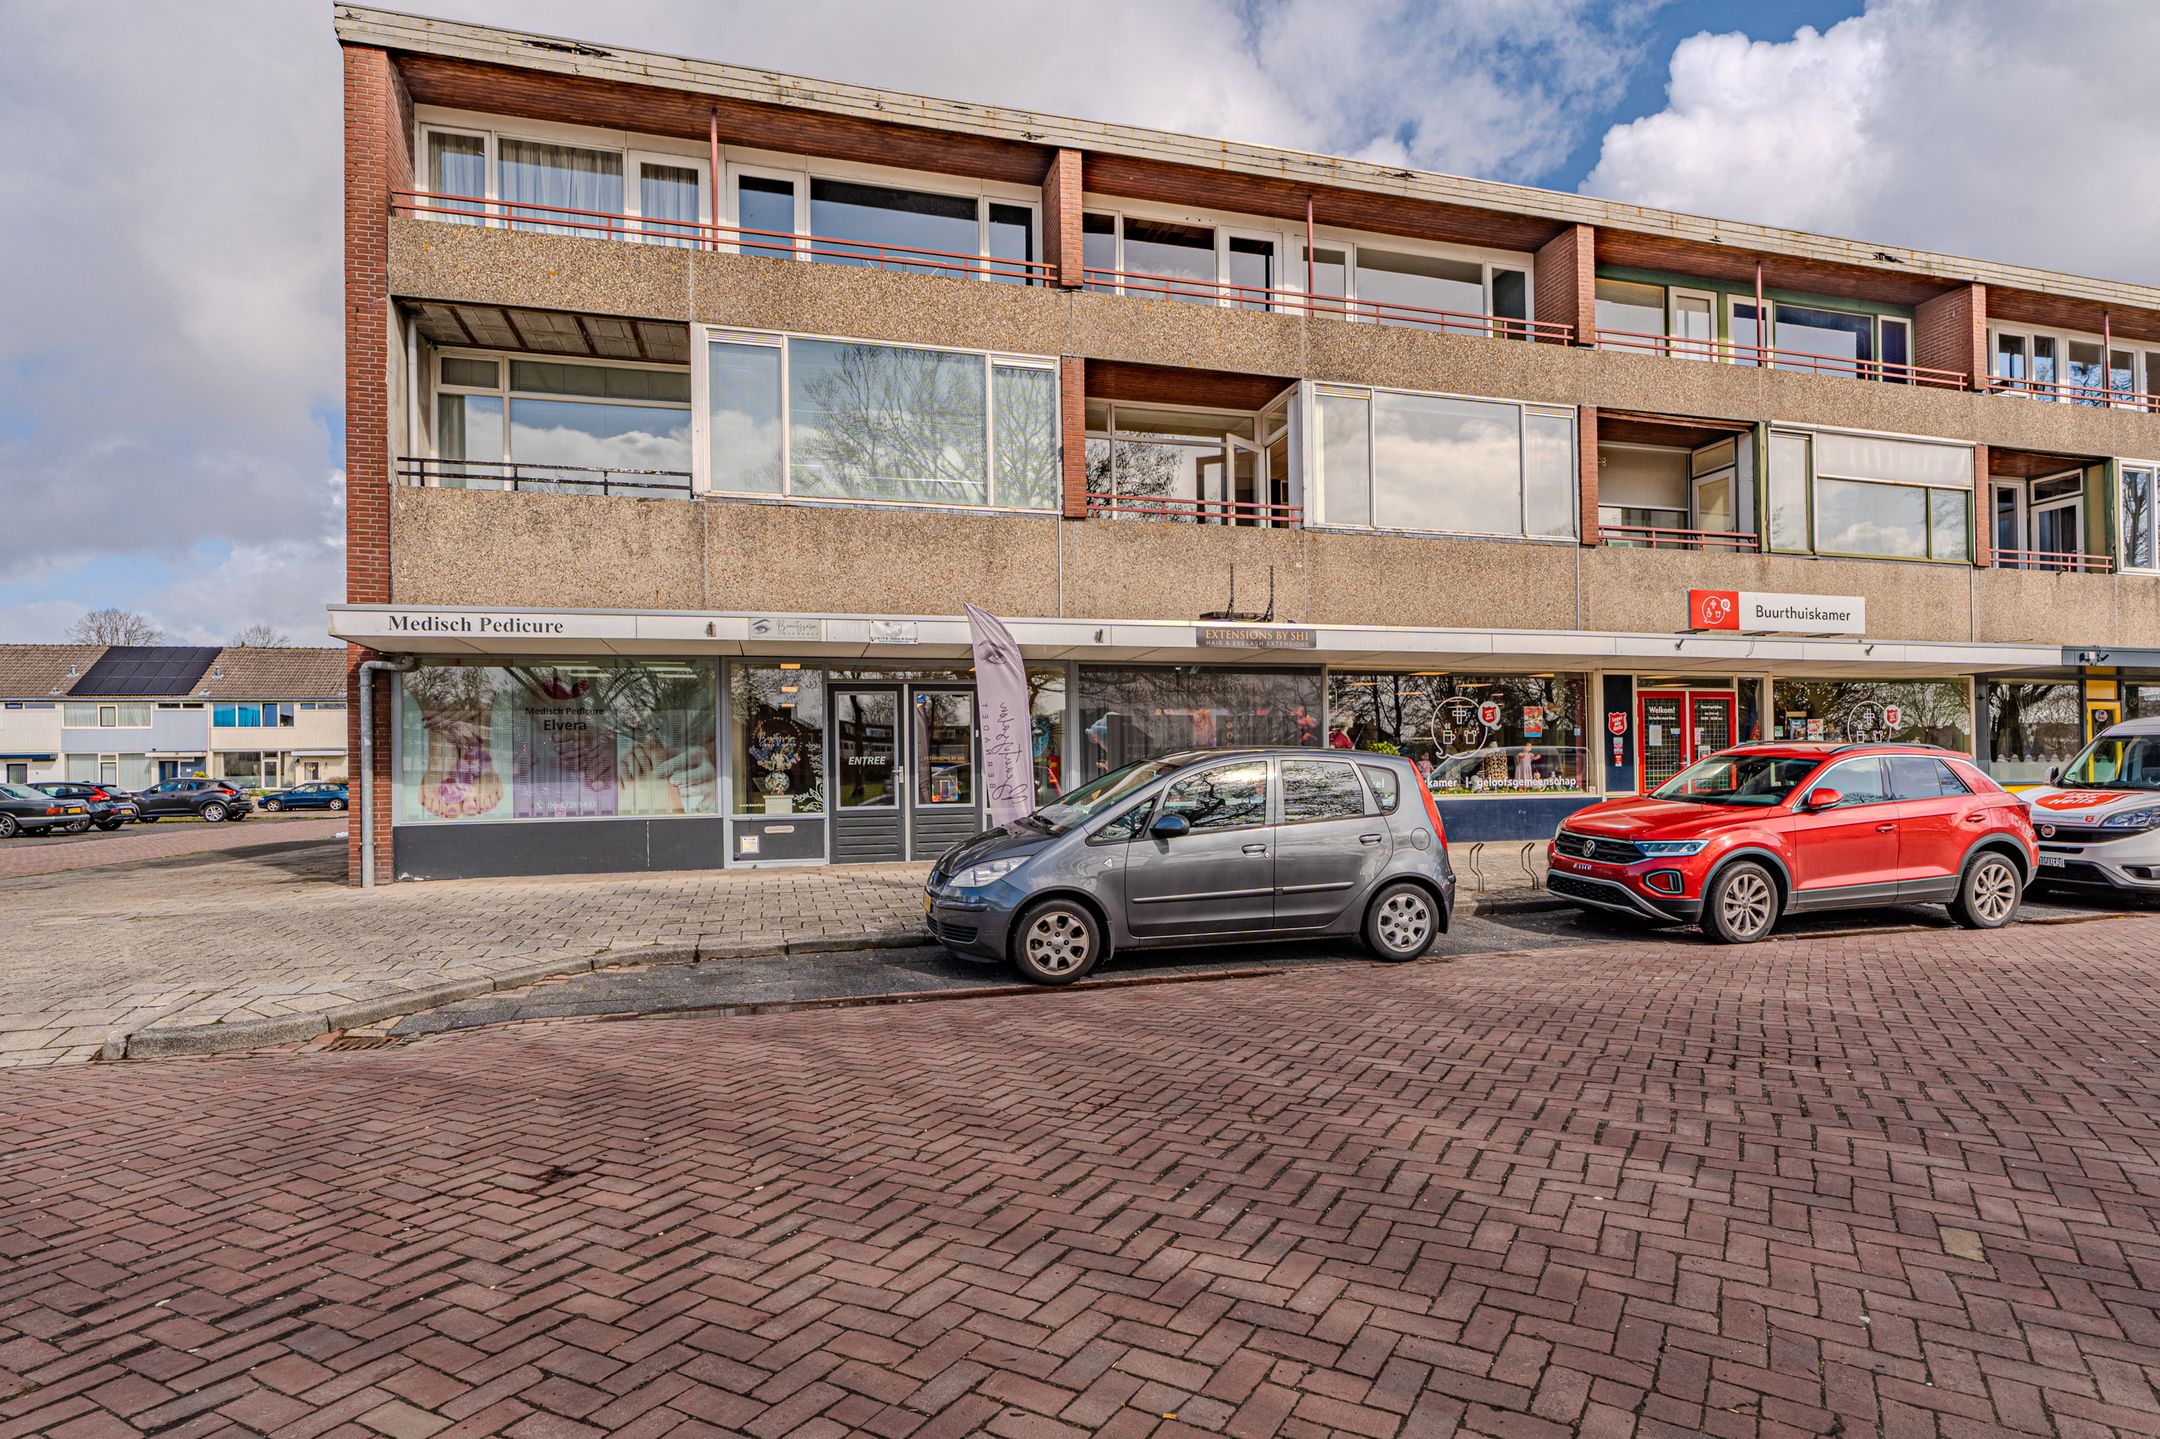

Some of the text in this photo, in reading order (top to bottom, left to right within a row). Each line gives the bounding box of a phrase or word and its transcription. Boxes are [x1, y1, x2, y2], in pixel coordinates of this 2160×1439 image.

[1755, 604, 1851, 621] Buurthuiskamer
[388, 615, 564, 634] Medisch Pedicure
[1205, 629, 1309, 641] EXTENSIONS BY SHI
[525, 707, 605, 715] Medisch Pedicure
[1648, 706, 1676, 714] Welkom!
[543, 719, 587, 731] Elvera
[848, 756, 886, 765] ENTREE
[1477, 775, 1577, 788] geloofsgemeenschap
